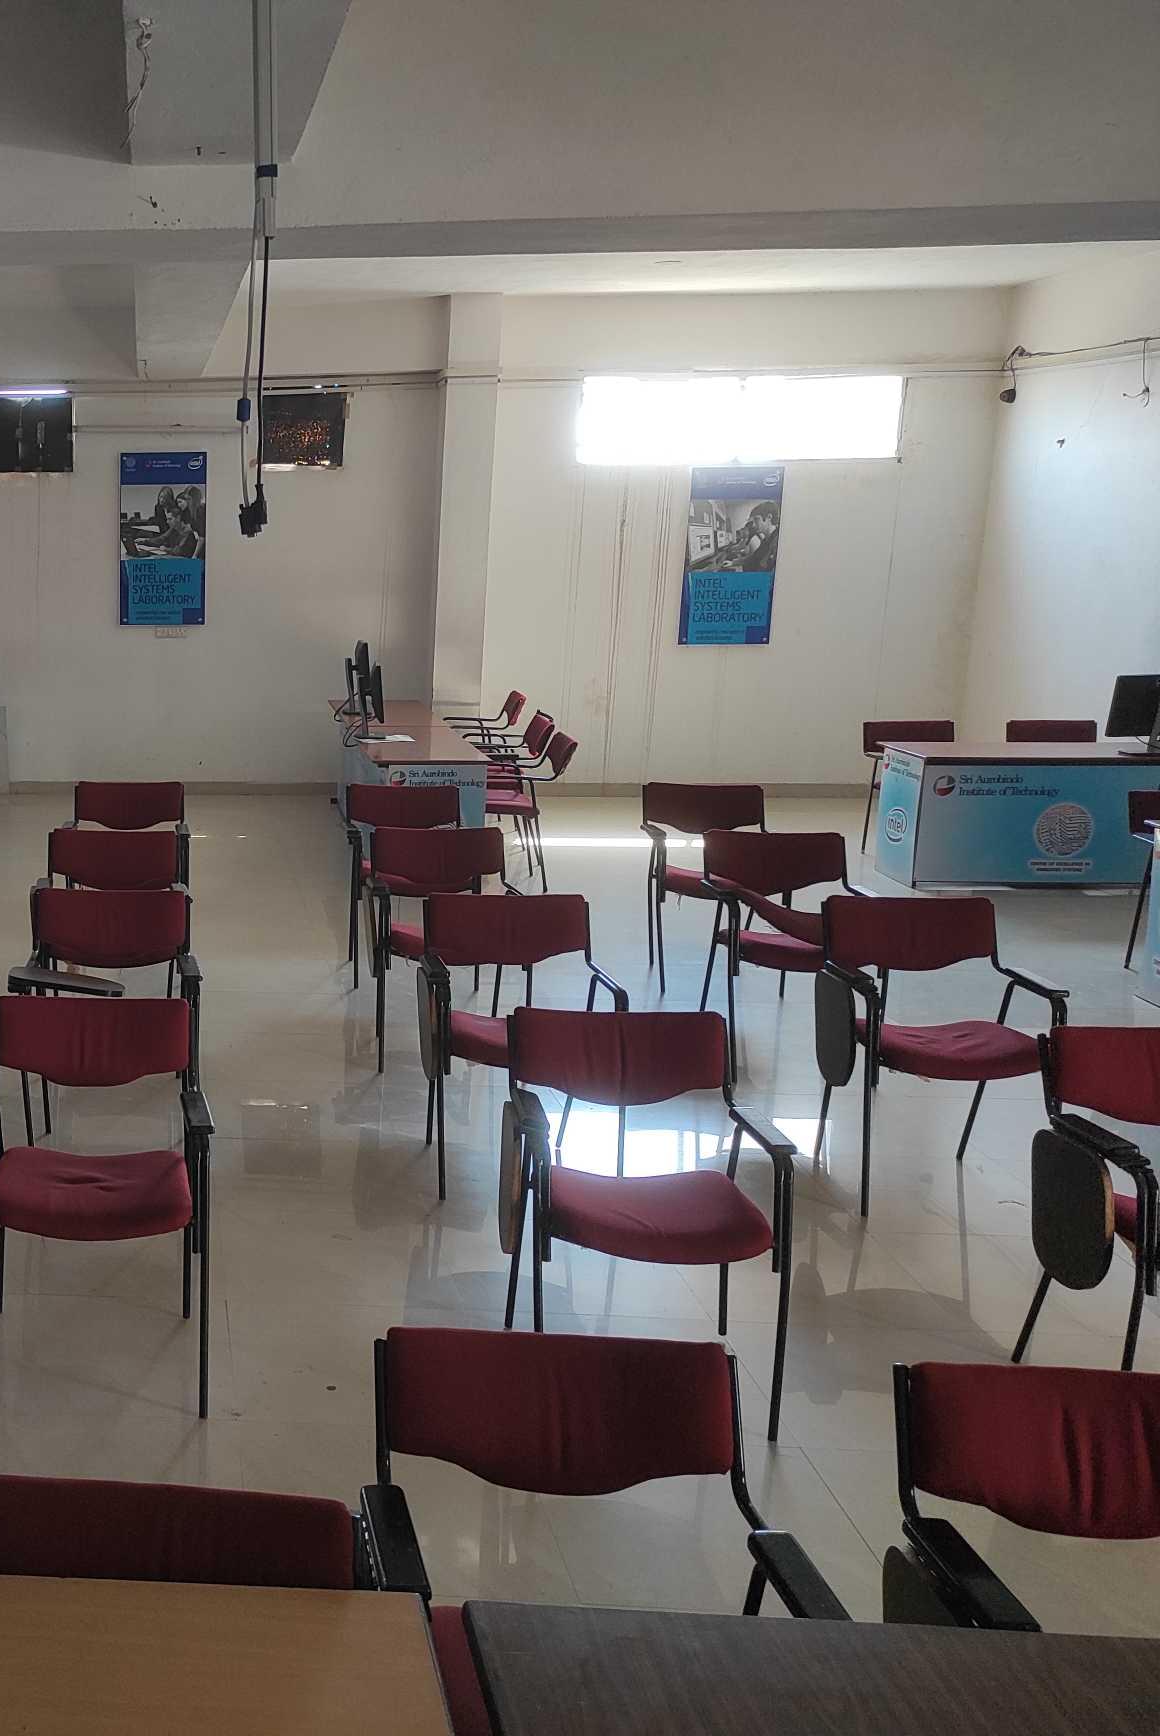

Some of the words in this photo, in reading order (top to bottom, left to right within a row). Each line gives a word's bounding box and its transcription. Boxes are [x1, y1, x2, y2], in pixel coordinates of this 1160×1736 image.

[133, 564, 156, 573] INTEL
[133, 574, 191, 584] INTELLIGENT
[696, 578, 724, 588] INTEL
[132, 584, 175, 594] SYSTEMS
[132, 594, 196, 605] LABORATORY
[694, 590, 761, 600] INTELLIGENT
[694, 601, 743, 612] SYSTEMS
[692, 612, 762, 623] LABORATORY
[408, 770, 419, 778] Sri
[959, 774, 973, 784] Sri
[975, 774, 1024, 784] Aurobindo
[959, 786, 997, 796] Institute
[1007, 786, 1060, 798] Technology
